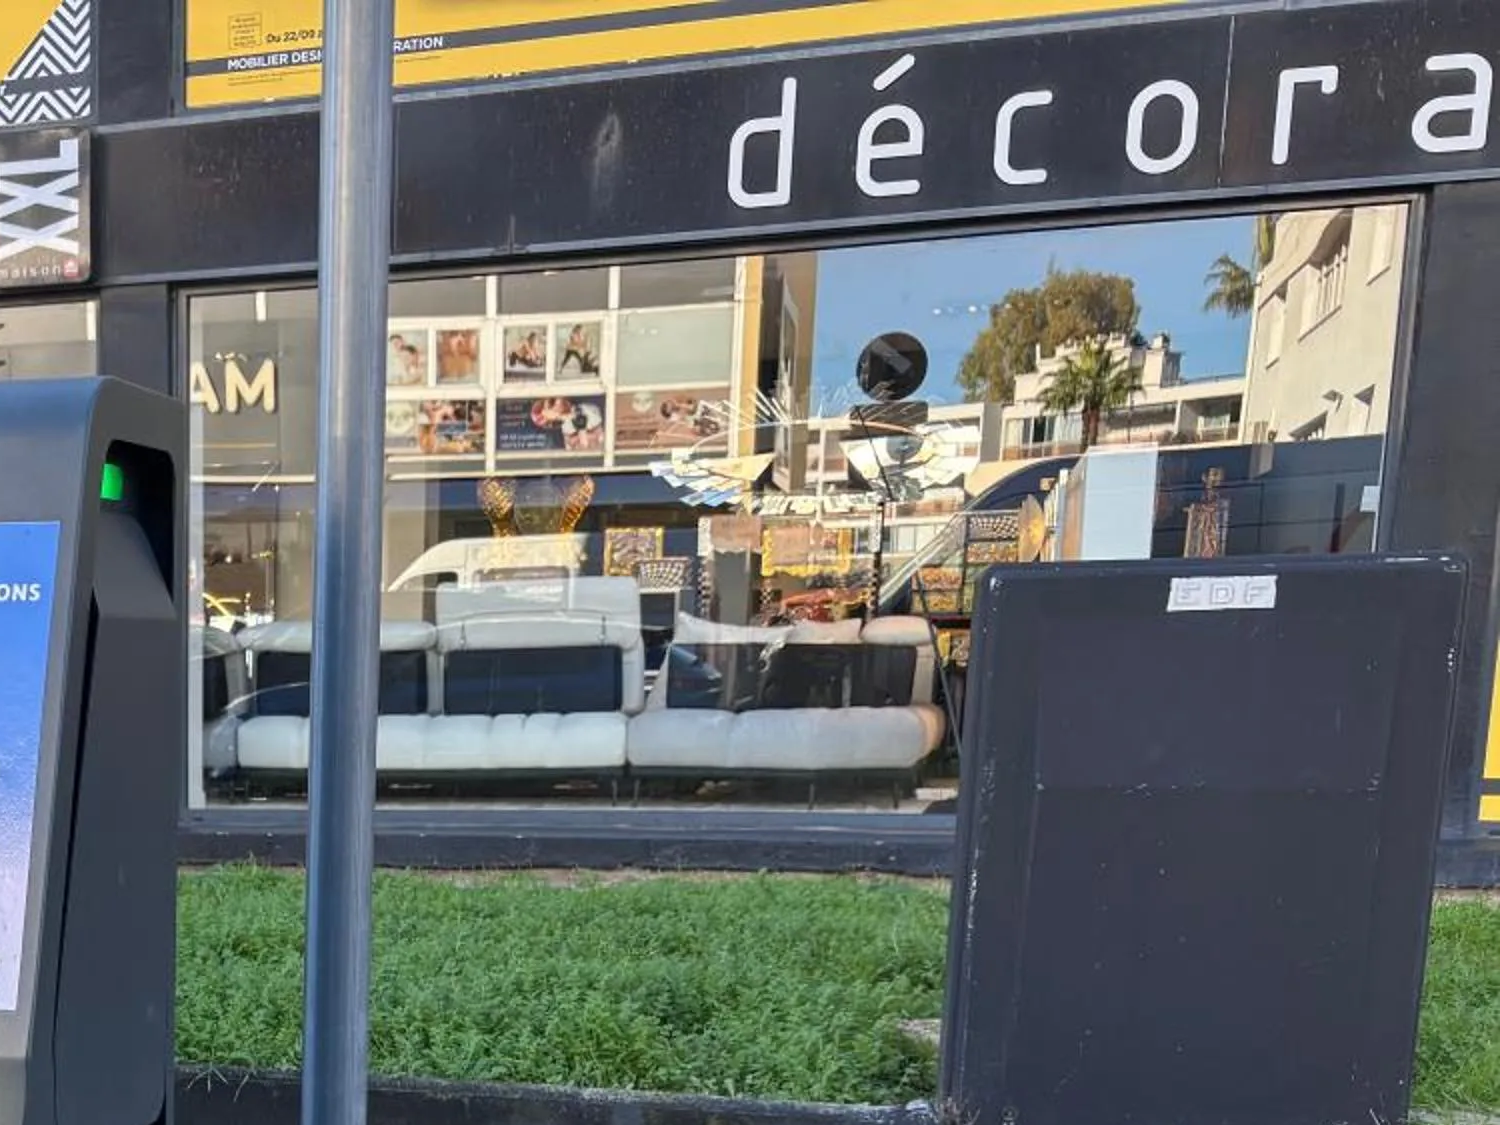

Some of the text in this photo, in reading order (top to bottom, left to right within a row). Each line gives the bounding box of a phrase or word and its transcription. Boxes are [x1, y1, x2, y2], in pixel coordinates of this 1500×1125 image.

[227, 36, 444, 71] MOBILIER DESI RATION
[727, 53, 1494, 209] décora
[1175, 581, 1272, 605] EDF
